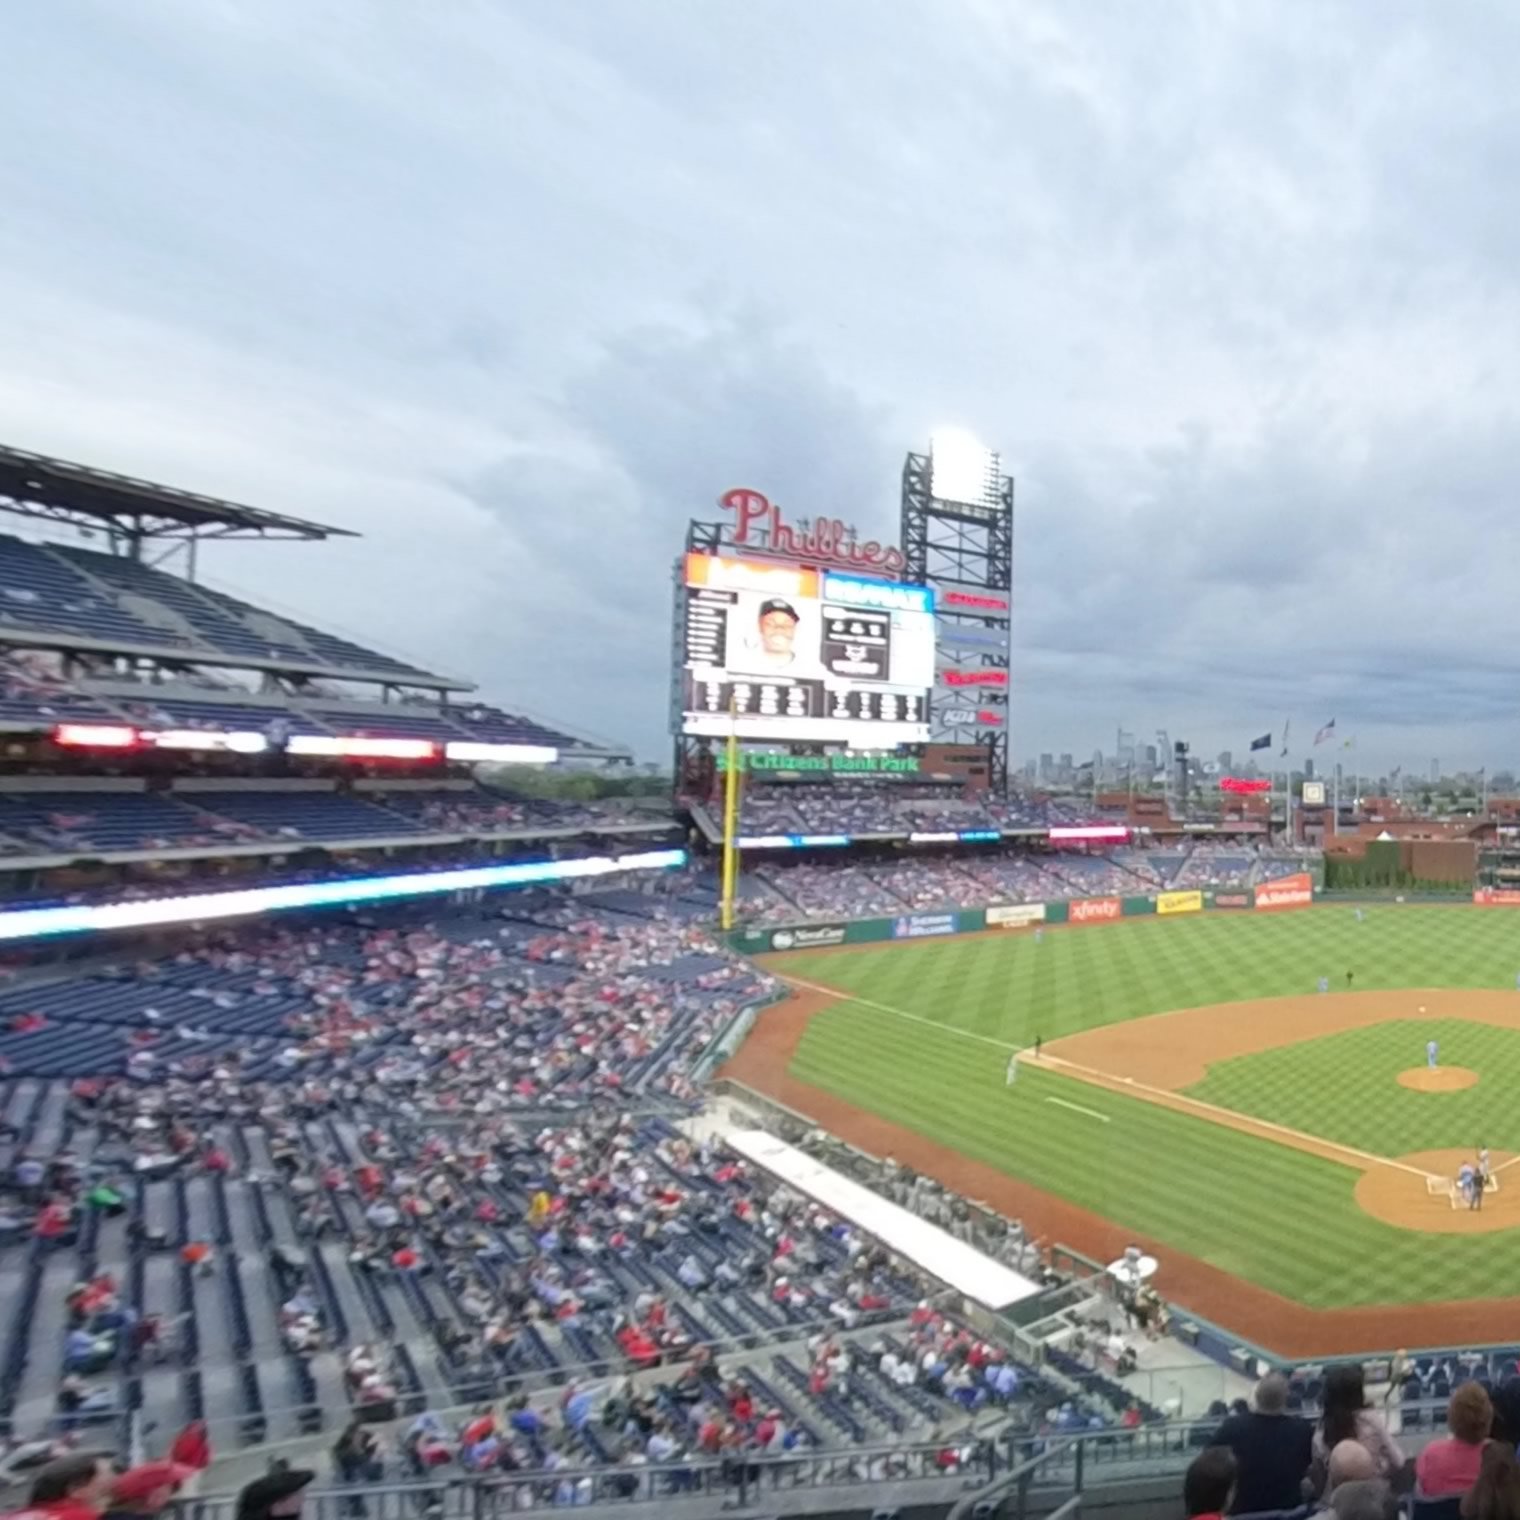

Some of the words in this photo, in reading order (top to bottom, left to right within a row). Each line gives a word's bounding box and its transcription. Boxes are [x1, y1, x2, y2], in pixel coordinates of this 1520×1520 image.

[719, 488, 906, 572] Phillies
[750, 754, 829, 770] Citizens
[832, 756, 878, 771] Bank
[880, 757, 919, 772] Park
[1071, 901, 1118, 920] xfinity
[794, 927, 845, 942] NovaCare
